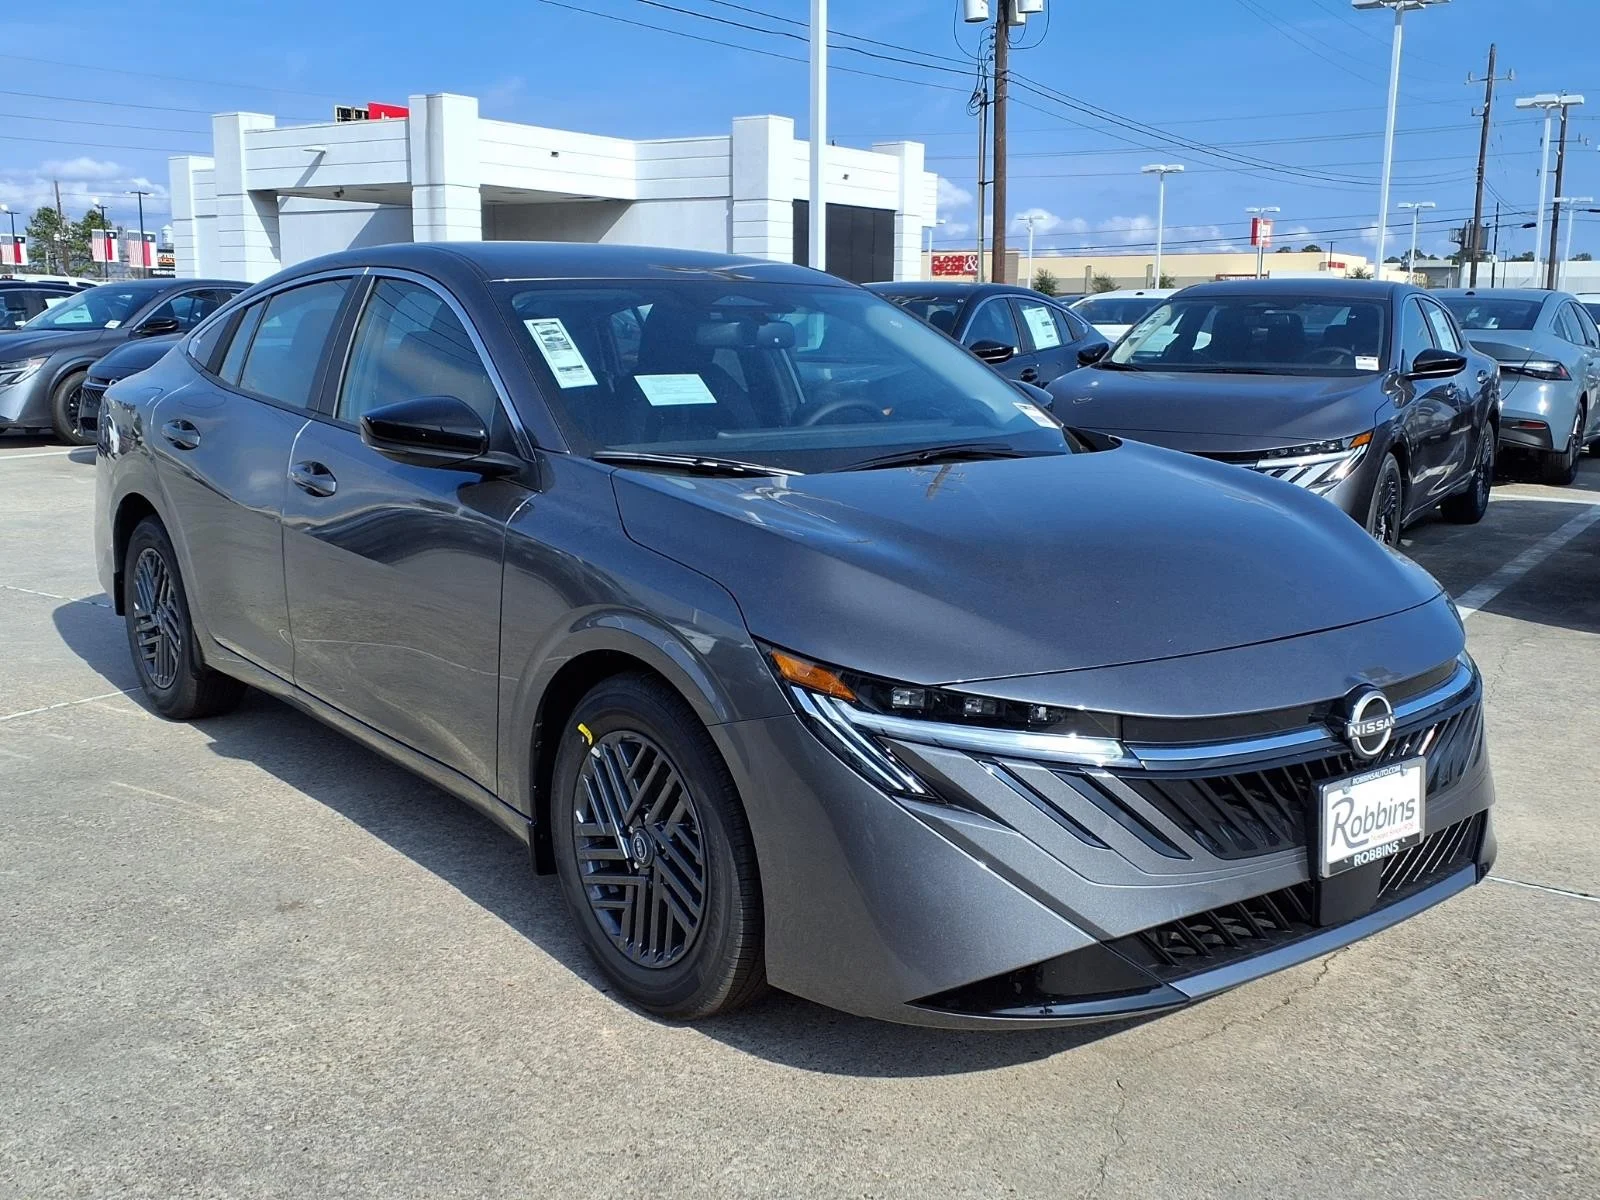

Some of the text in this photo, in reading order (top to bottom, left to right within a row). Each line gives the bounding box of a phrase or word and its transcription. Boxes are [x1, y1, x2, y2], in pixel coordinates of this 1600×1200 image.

[932, 255, 978, 271] FLOOR &
[932, 263, 964, 271] DECOR
[1348, 715, 1396, 738] NISSAN
[1331, 797, 1416, 849] Robbins
[1354, 841, 1400, 866] ROBBINS
